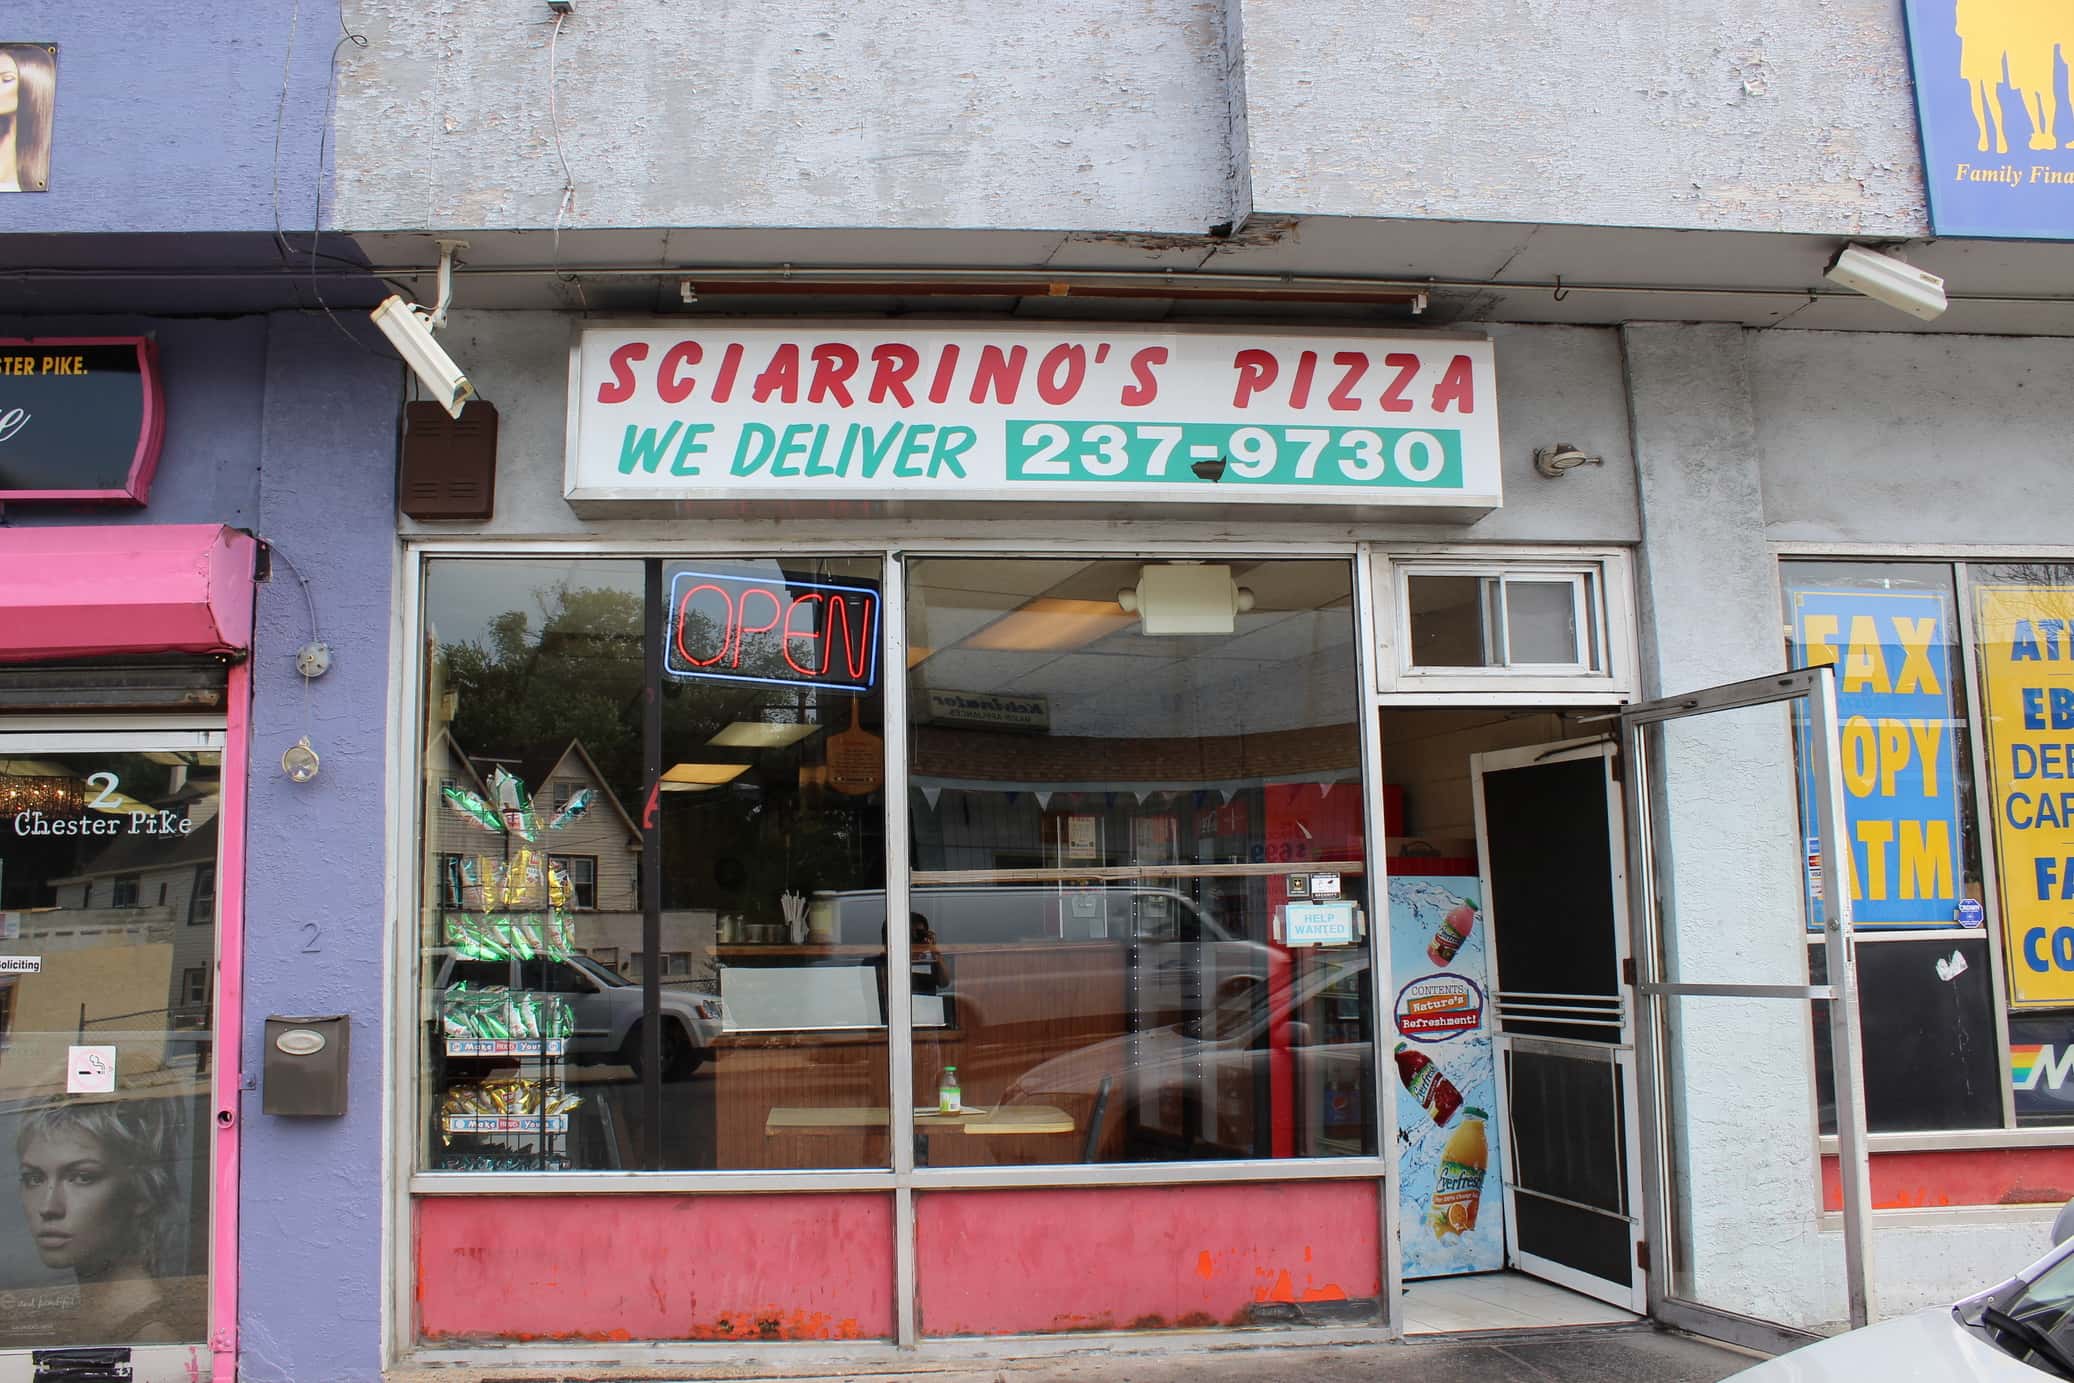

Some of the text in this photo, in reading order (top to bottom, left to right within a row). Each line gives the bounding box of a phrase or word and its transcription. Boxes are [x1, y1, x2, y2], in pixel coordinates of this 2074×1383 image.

[1955, 163, 2023, 187] Family
[0, 356, 88, 375] TER PIKE.
[598, 340, 1474, 413] SCIARRINO'S PIZZA
[618, 420, 1446, 482] WE DELIVER 237-9730
[675, 584, 871, 679] OPEN
[2011, 619, 2074, 661] AT
[1804, 614, 1943, 695] FAX
[1842, 715, 1943, 798] OPY
[87, 771, 124, 809] 2
[15, 808, 193, 836] Chester Pike
[1294, 924, 1345, 935] WANTED
[1304, 913, 1335, 924] HELP
[299, 922, 322, 954] 2
[0, 959, 41, 972] oliciting
[1411, 984, 1464, 996] CONTENTS
[1413, 995, 1464, 1012] Nature's
[1402, 1015, 1477, 1029] Refreshment!
